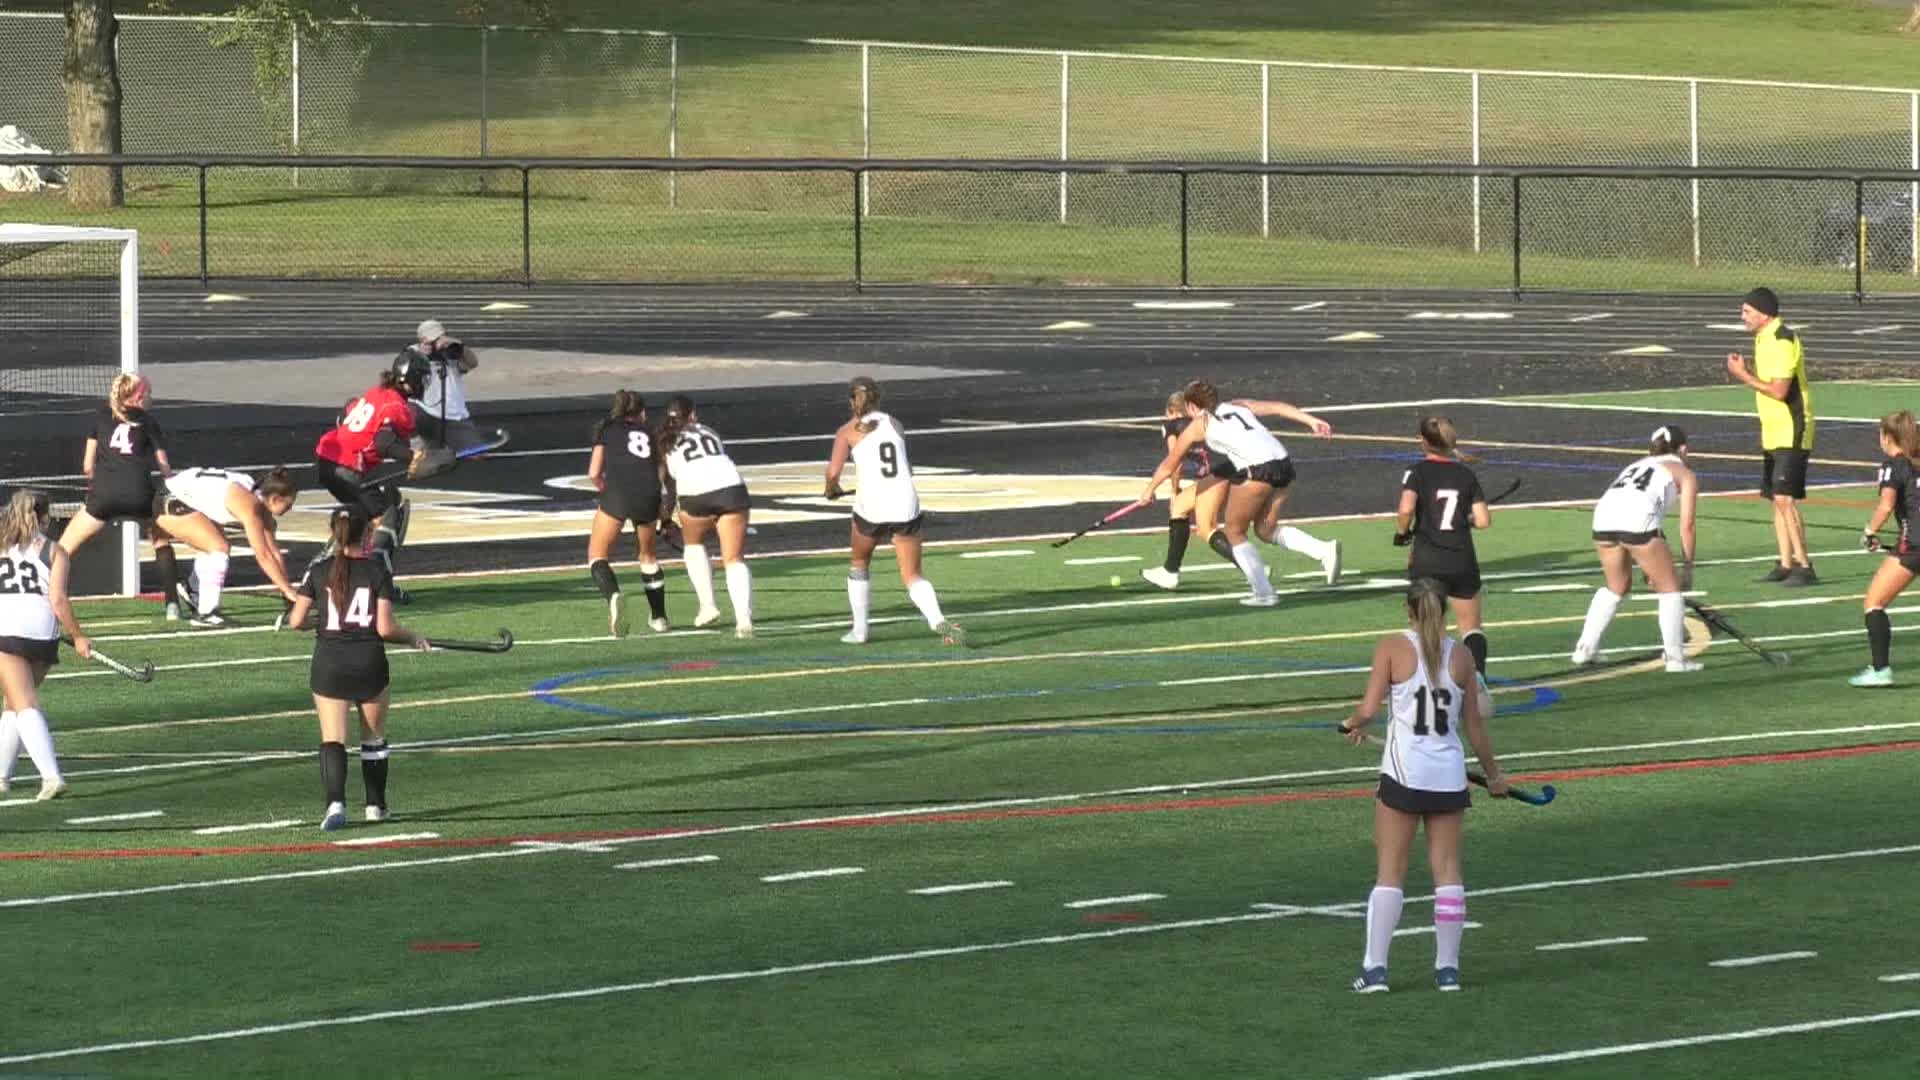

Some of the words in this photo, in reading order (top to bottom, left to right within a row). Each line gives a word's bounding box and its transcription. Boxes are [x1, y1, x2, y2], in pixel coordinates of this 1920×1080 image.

[1222, 412, 1254, 430] 7
[110, 423, 133, 454] 4
[627, 431, 651, 458] 8
[677, 434, 722, 462] 20
[879, 441, 898, 478] 9
[1611, 466, 1654, 490] 24
[1437, 489, 1460, 530] 7
[0, 557, 44, 595] 22
[326, 587, 373, 631] 14
[1413, 686, 1452, 736] 16
